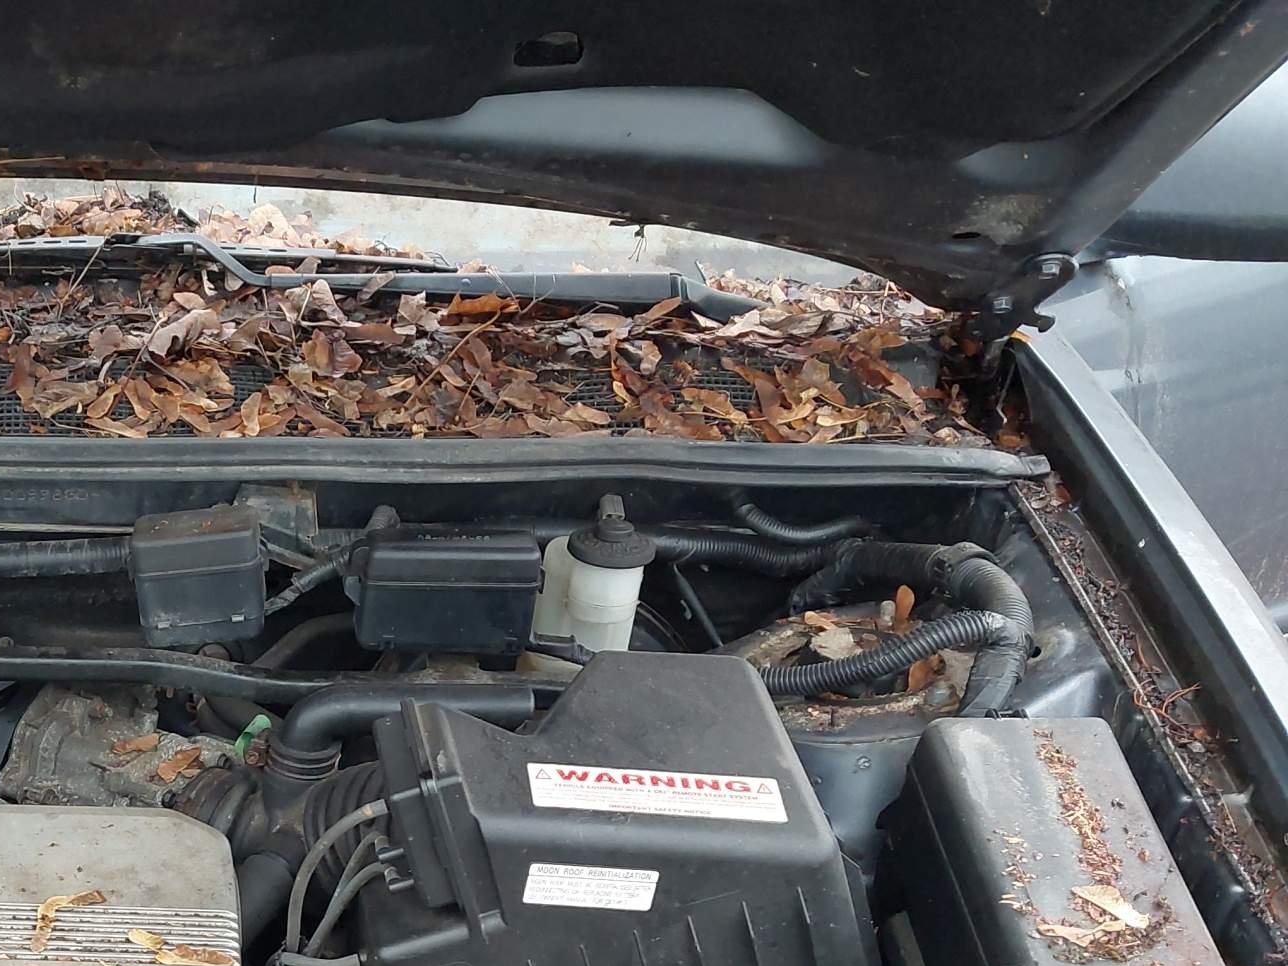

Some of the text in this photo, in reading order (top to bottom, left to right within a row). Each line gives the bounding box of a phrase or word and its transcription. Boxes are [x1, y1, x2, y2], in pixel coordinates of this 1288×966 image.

[555, 768, 751, 793] WARNING
[537, 865, 652, 881] MOON ROOF REINITIALIZATION
